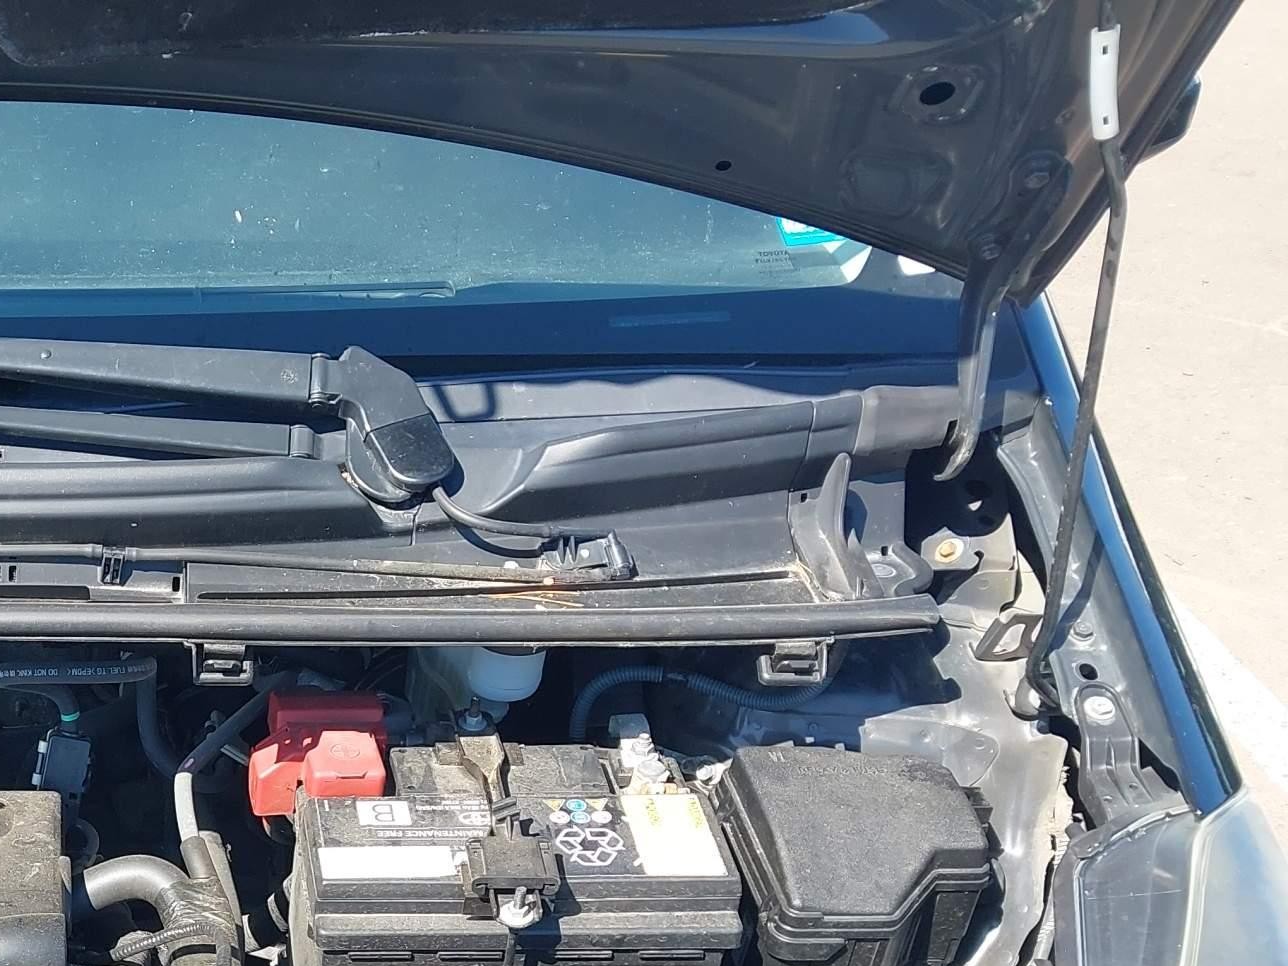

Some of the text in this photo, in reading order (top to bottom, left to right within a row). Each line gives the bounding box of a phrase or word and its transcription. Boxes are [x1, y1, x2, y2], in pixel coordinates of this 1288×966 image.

[372, 803, 395, 823] B
[376, 829, 485, 838] MAINTENANCE FREE
